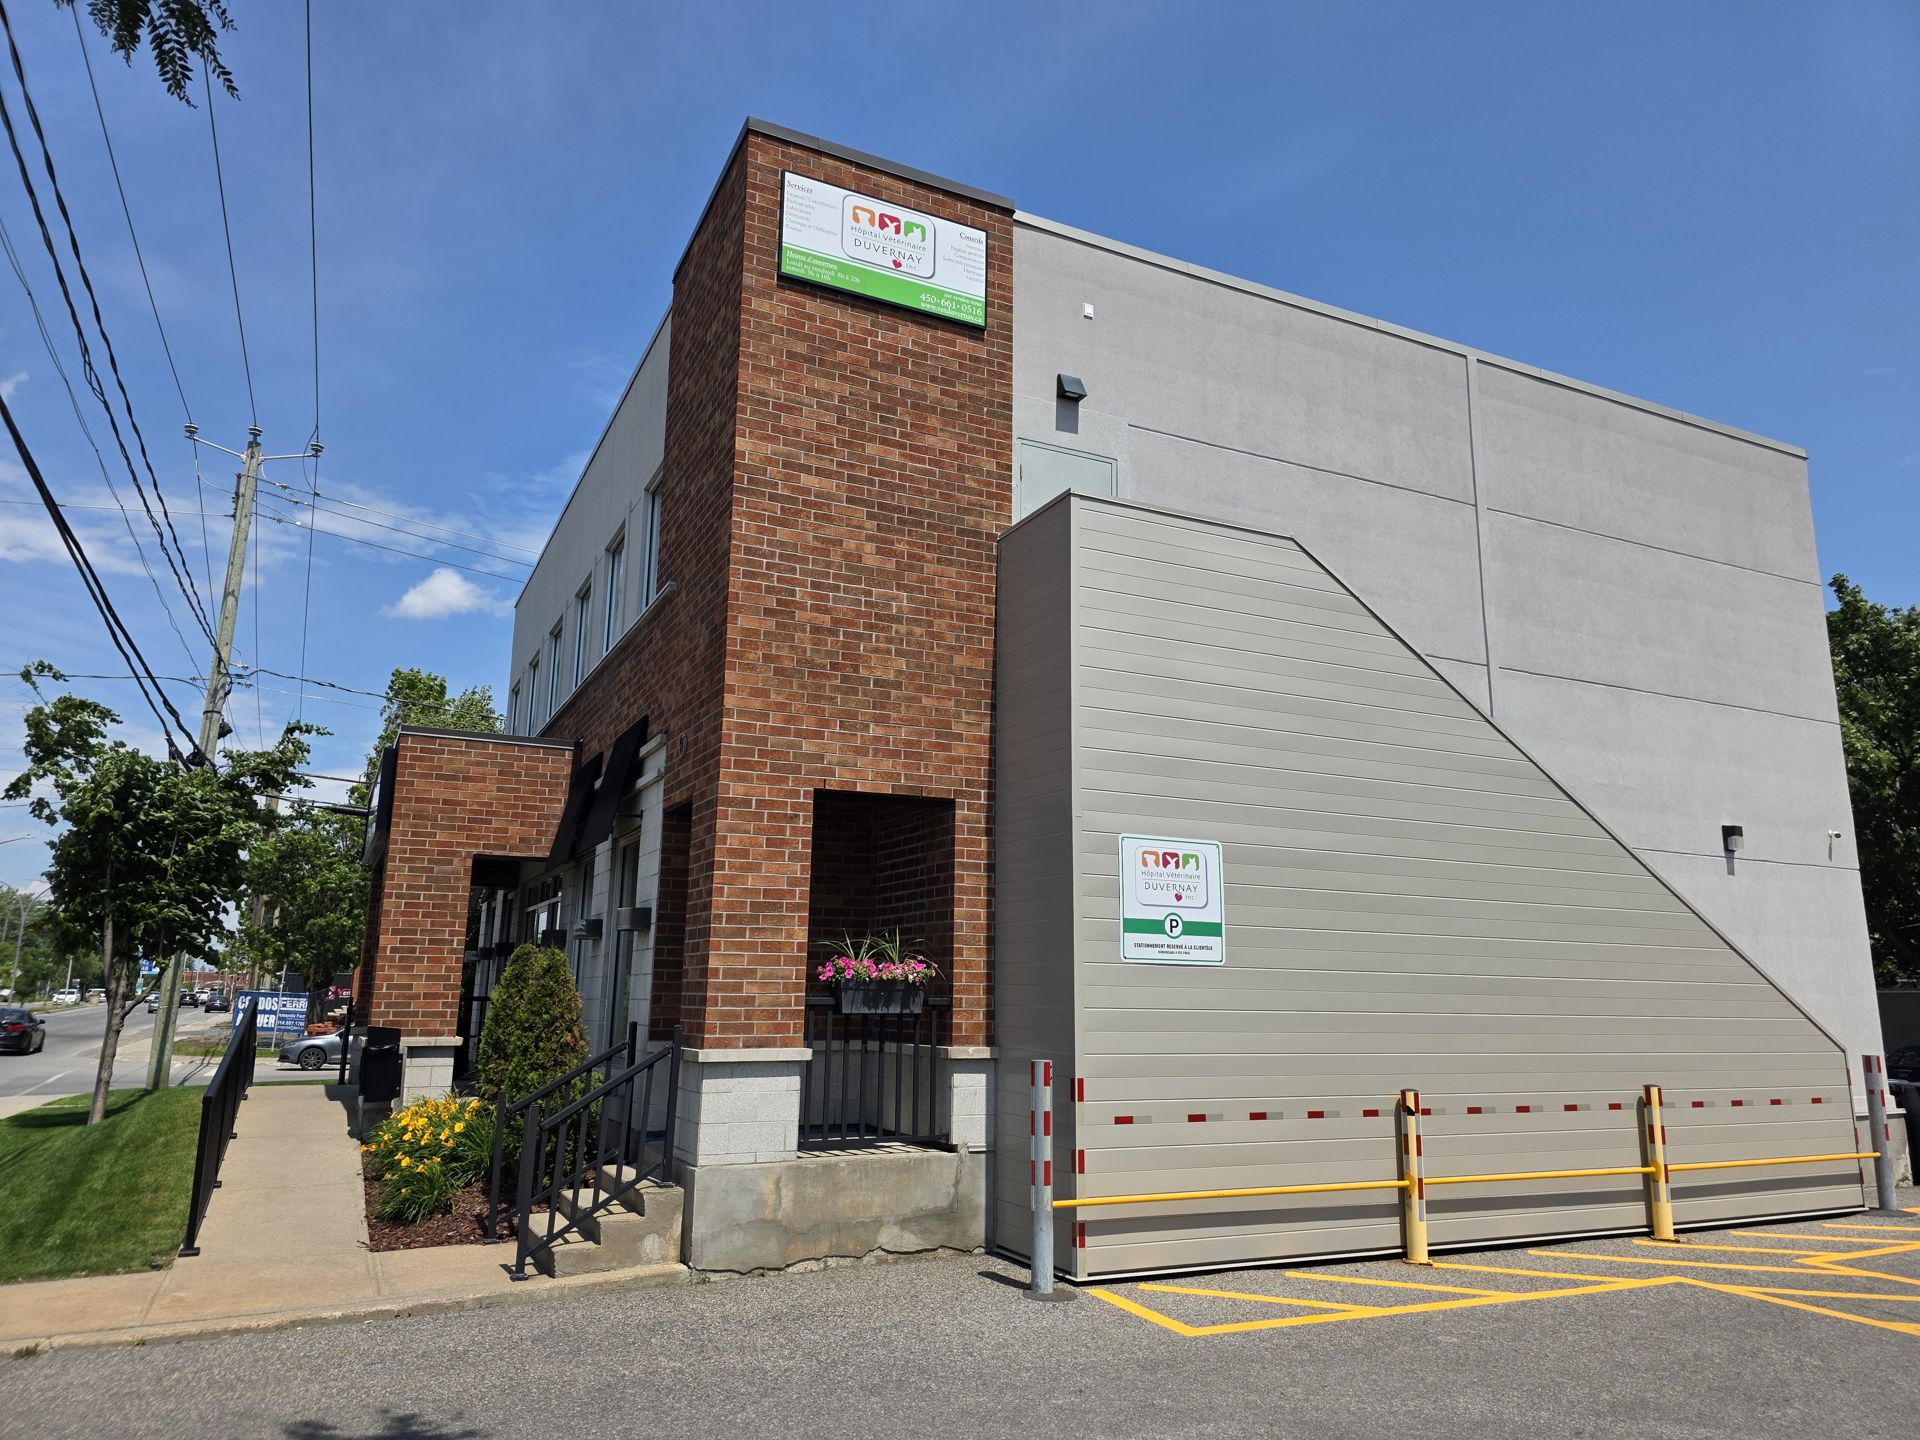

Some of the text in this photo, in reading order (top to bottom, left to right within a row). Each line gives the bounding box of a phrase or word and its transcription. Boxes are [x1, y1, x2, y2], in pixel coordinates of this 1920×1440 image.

[787, 180, 812, 193] Services
[851, 225, 926, 252] Hôpital Vétérinaire
[854, 238, 922, 264] DUVERNAY
[1141, 870, 1201, 880] Hôpital Vétérinaire
[1144, 881, 1198, 893] DUVERNAY
[1169, 918, 1179, 933] P
